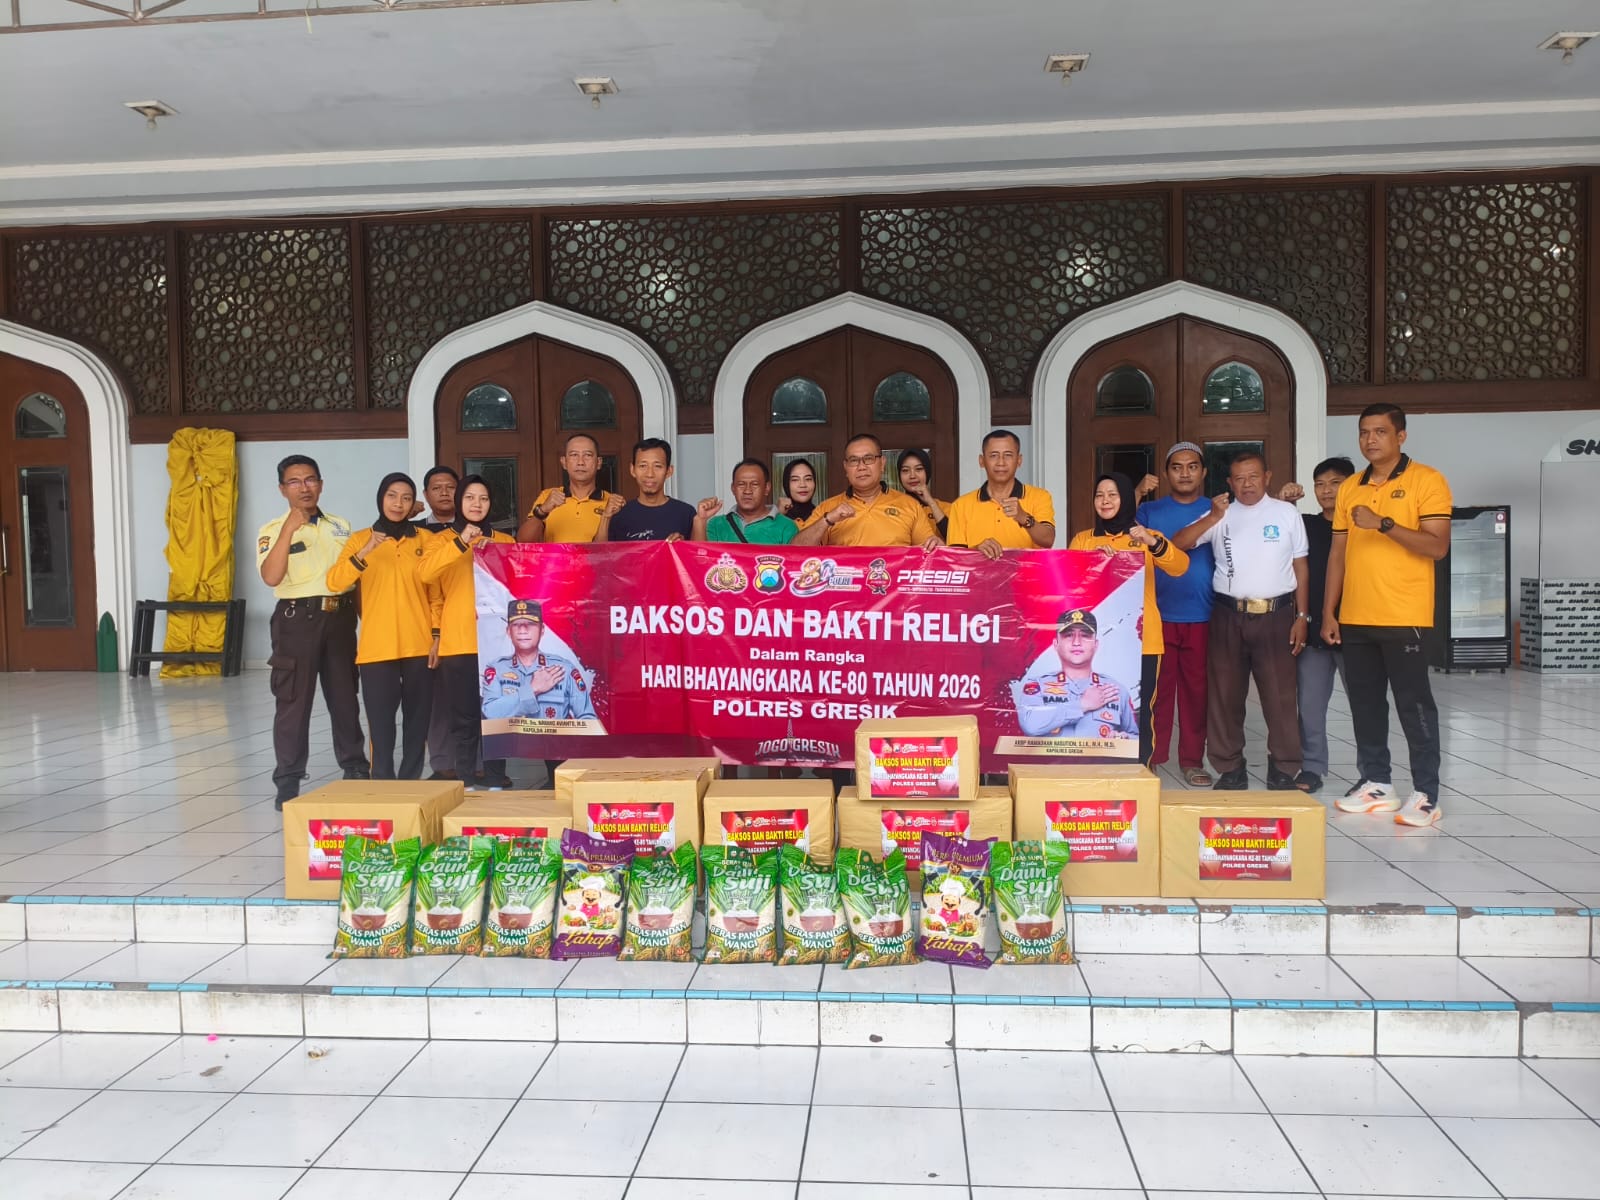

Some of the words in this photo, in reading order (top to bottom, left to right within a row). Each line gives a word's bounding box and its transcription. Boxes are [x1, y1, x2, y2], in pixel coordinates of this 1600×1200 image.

[1224, 536, 1234, 577] SECURITY
[897, 570, 970, 585] PRESISI
[610, 605, 725, 635] BAKSOS
[735, 607, 793, 637] DAN
[803, 609, 892, 641] BAKTI
[902, 612, 1000, 643] RELIGI
[749, 647, 800, 661] Dalam
[805, 649, 865, 665] Rangka
[641, 665, 682, 688] HARI
[683, 666, 813, 693] BHAYANGKARA
[818, 670, 868, 695] KE-80
[872, 672, 934, 697] TAHUN
[938, 673, 981, 699] 2026
[713, 700, 803, 718] POLRES
[810, 702, 898, 719] GRESIK
[755, 738, 790, 756] JOGO
[900, 757, 913, 767] DAN
[593, 823, 616, 832] BAKSOS
[617, 823, 630, 832] DAN
[631, 823, 649, 832] BAKTI
[1077, 822, 1090, 831] DAN
[727, 831, 751, 841] BAKSOS
[752, 831, 764, 841] DAN
[765, 830, 784, 840] BAKTI
[1231, 838, 1245, 848] DAN
[1246, 839, 1265, 849] BAKTI
[355, 866, 406, 893] Suji
[429, 868, 480, 892] Suji
[501, 871, 551, 891] Suji
[1000, 867, 1047, 881] Daun
[724, 873, 771, 895] Suji
[800, 873, 837, 893] Suj
[1013, 875, 1059, 898] Suji
[364, 921, 401, 938] PANDAN
[442, 919, 478, 937] PANDAN
[510, 919, 547, 937] PANDAN
[650, 920, 687, 937] PANDAN
[710, 925, 737, 940] BERAS
[738, 923, 774, 940] PANDAN
[788, 924, 814, 940] BERAS
[814, 923, 848, 940] PANDAN
[350, 936, 384, 947] WANGI
[427, 936, 461, 946] WANGI
[497, 936, 529, 946] WANGI
[637, 935, 670, 947] WANGI
[724, 938, 758, 949] WANGI
[801, 938, 836, 949] WANGI
[1004, 930, 1032, 946] BERAS
[1033, 928, 1066, 945] PANDAN
[874, 943, 906, 954] WANGI
[924, 936, 974, 957] Lahap
[1019, 945, 1054, 956] WANGI
